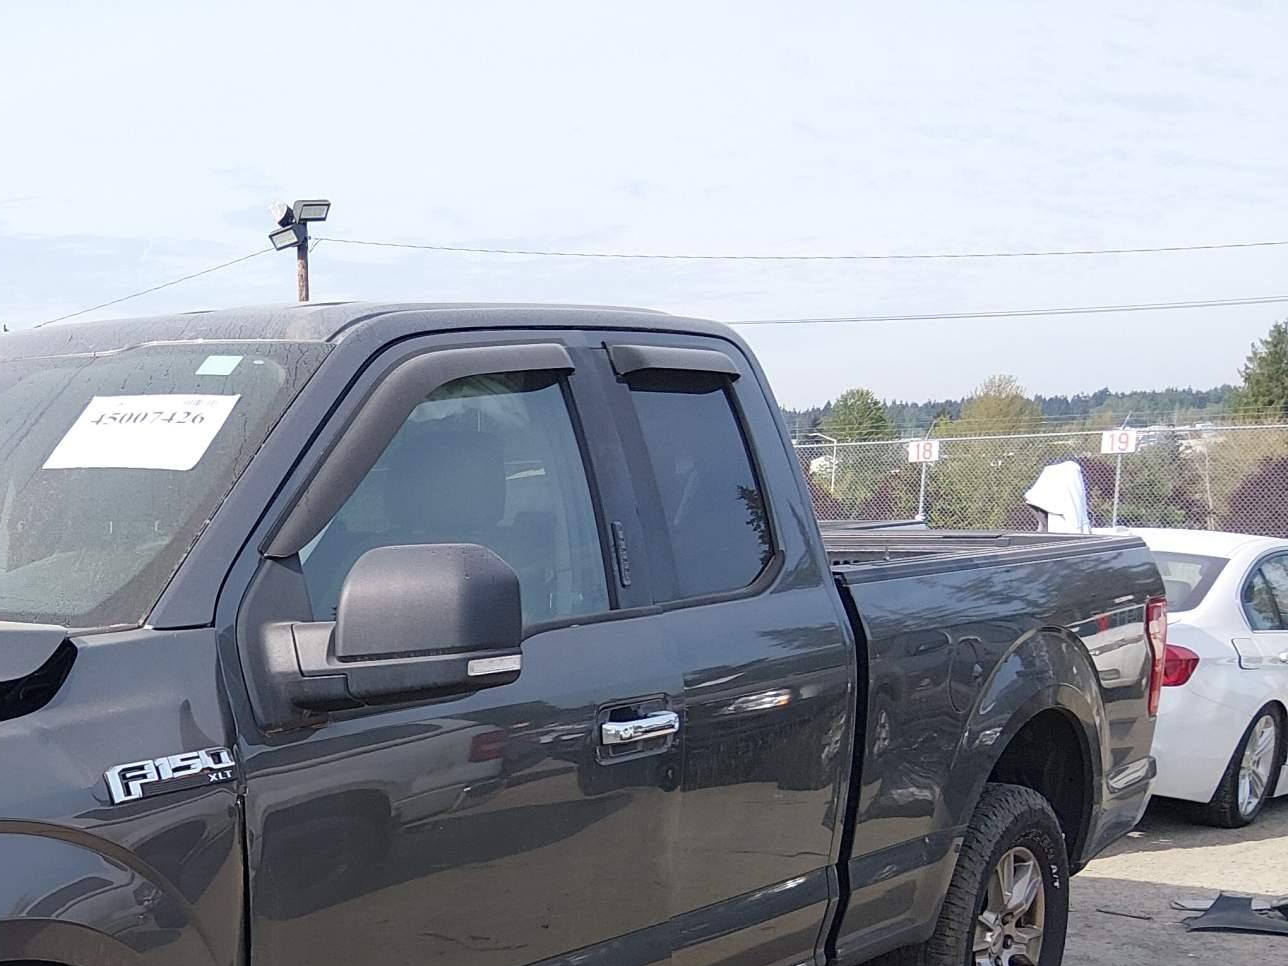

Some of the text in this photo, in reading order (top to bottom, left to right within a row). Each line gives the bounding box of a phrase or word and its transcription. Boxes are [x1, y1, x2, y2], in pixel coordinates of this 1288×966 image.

[91, 411, 206, 426] 45007426
[1108, 432, 1130, 452] 19
[914, 442, 933, 460] 18
[208, 769, 233, 782] XLT
